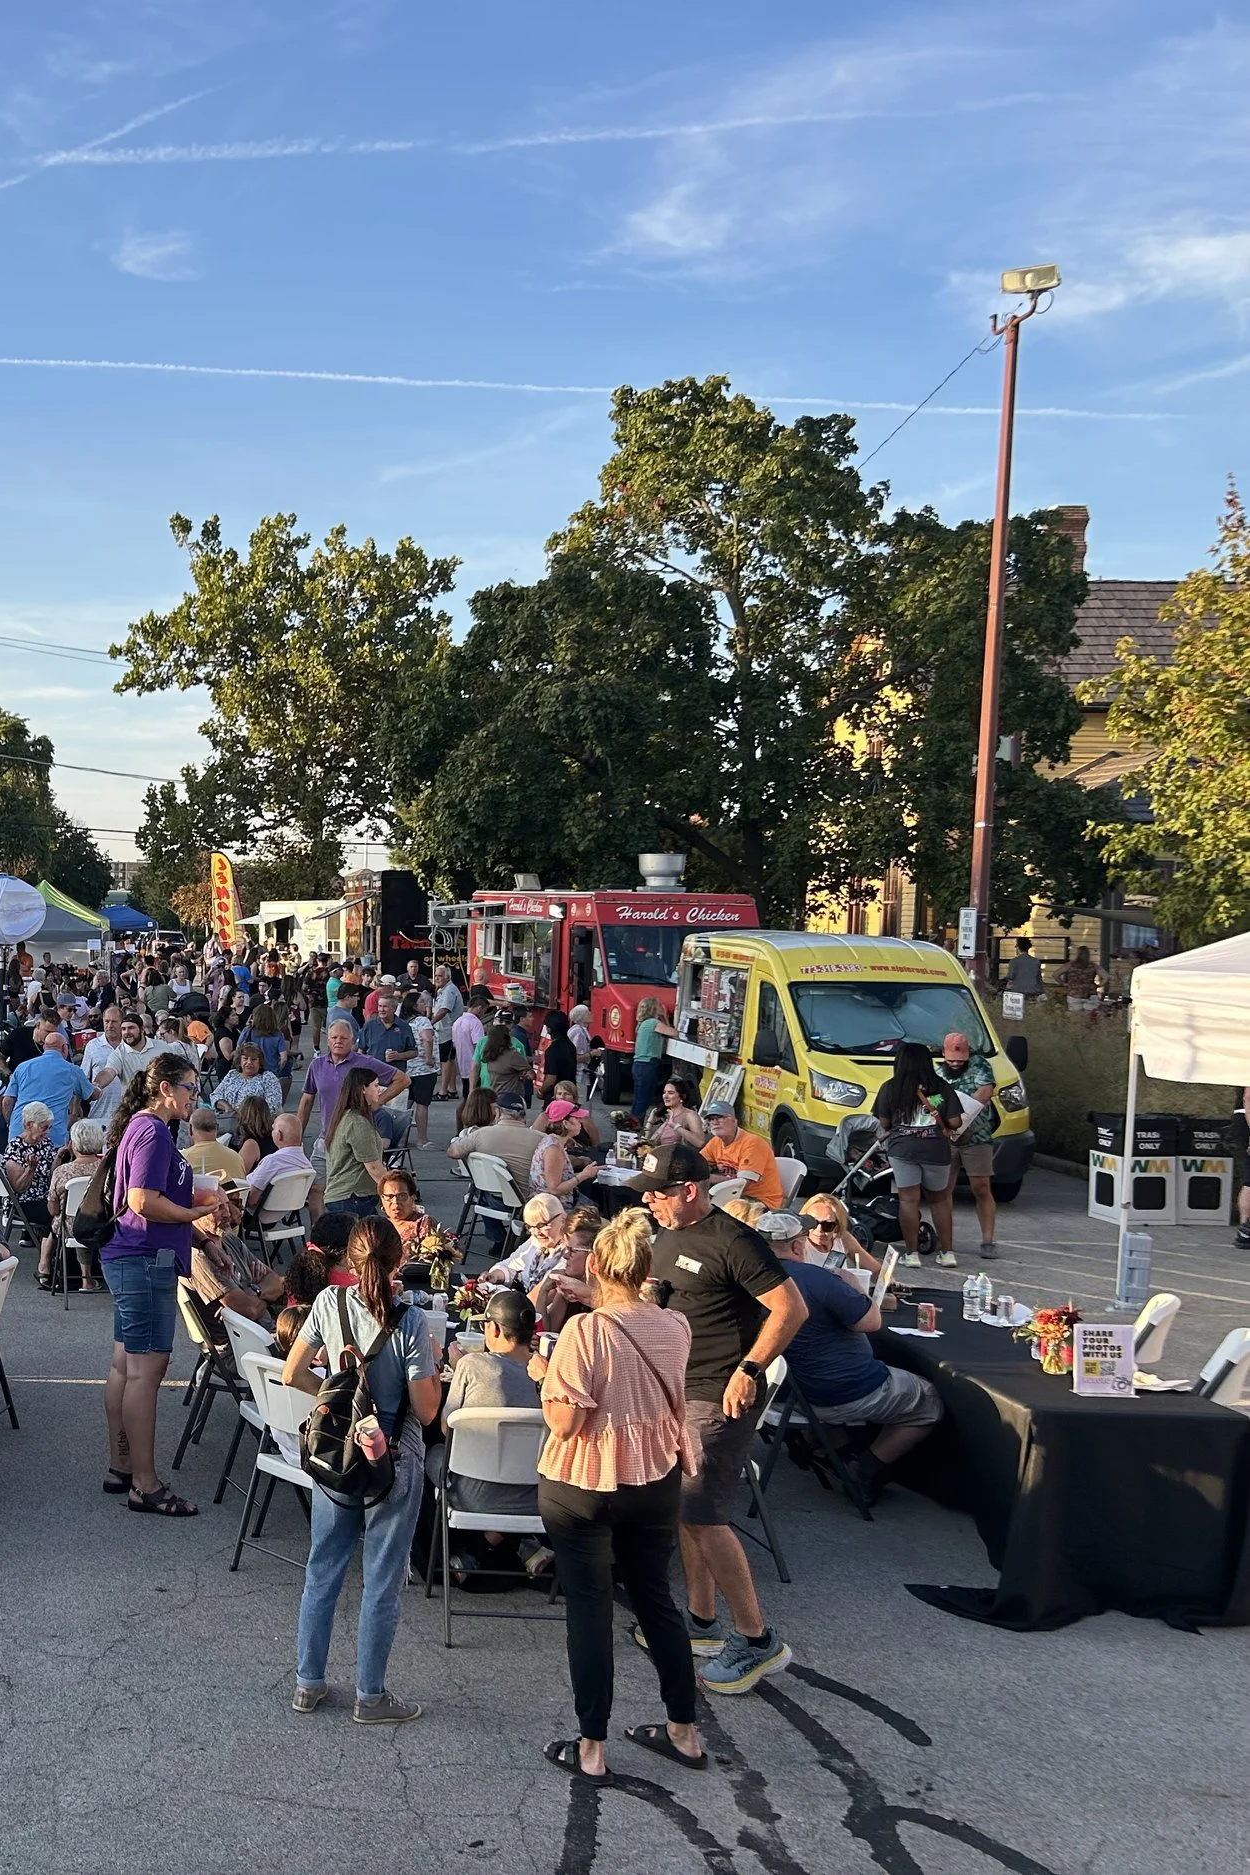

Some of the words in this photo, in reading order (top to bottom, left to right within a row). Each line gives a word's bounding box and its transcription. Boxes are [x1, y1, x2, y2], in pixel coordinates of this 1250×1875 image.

[616, 906, 680, 921] Harold's
[686, 907, 741, 923] Chicken
[1139, 1142, 1161, 1150] ONLY
[1195, 1142, 1218, 1150] ONLY
[1091, 1153, 1117, 1171] WM
[1131, 1159, 1172, 1173] WM
[1182, 1159, 1227, 1173] WM
